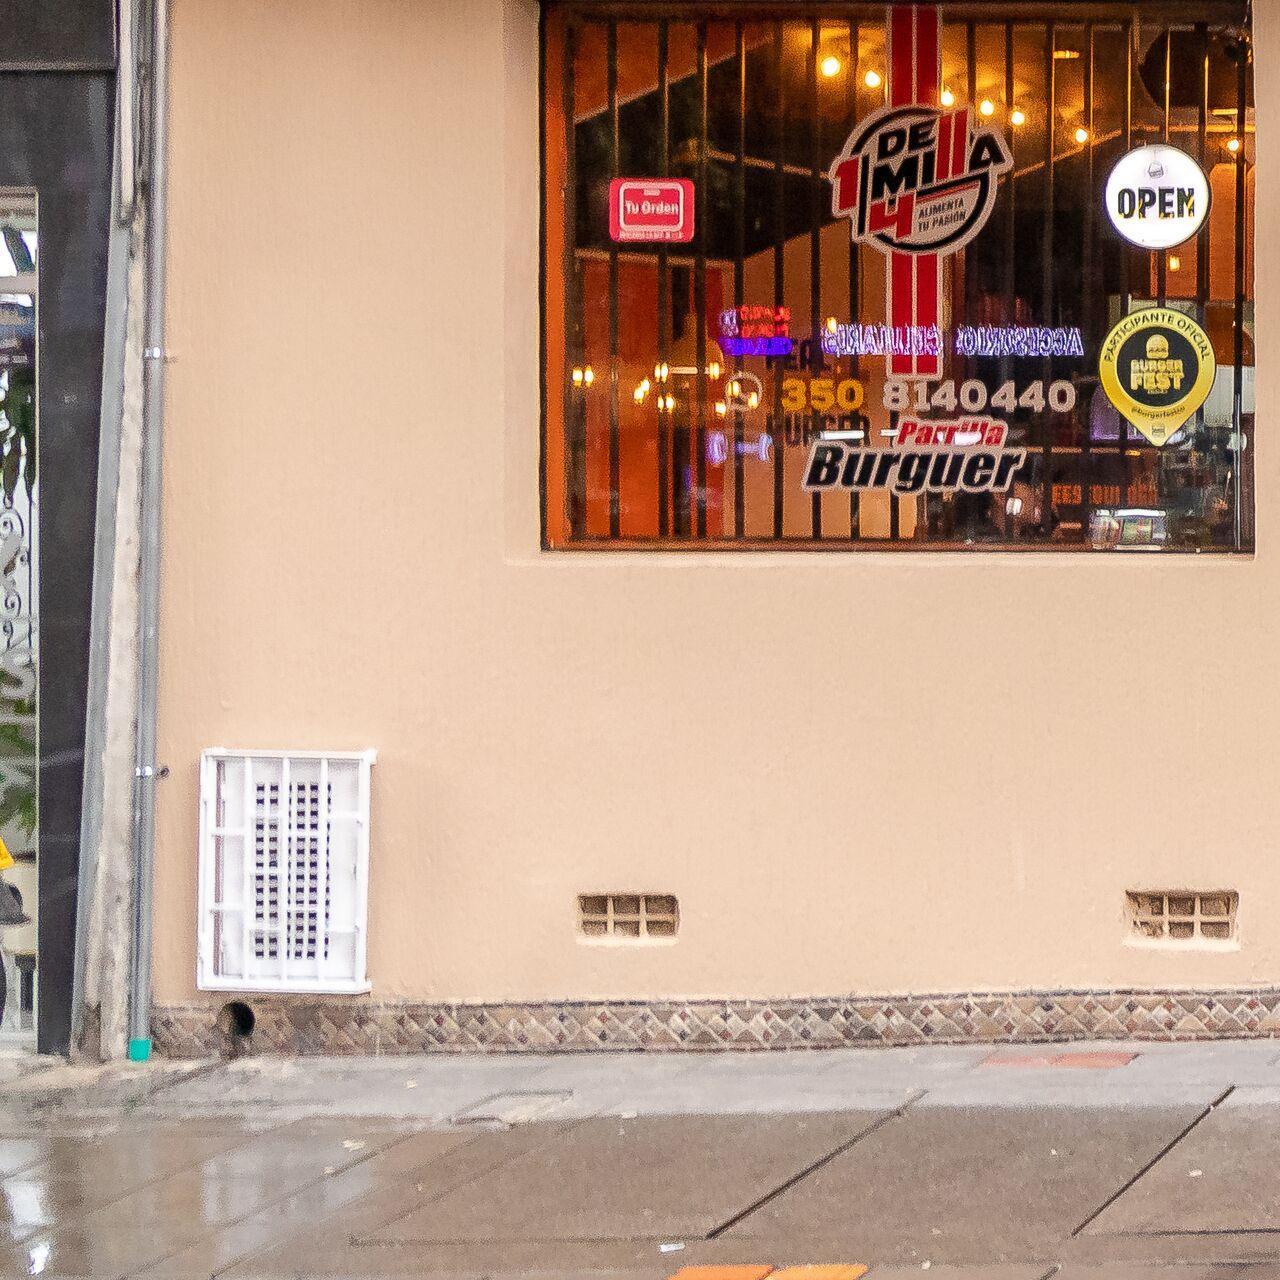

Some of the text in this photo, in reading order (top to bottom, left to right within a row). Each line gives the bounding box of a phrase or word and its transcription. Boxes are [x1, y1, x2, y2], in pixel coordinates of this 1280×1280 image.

[877, 118, 938, 160] DE
[641, 200, 679, 215] Orden
[1117, 186, 1195, 219] OPEN
[1104, 312, 1210, 362] PARTICIPANTE OFICIAL
[1130, 359, 1183, 373] BURGER
[1130, 372, 1185, 391] FEST
[781, 377, 1076, 413] 350 8140440
[805, 444, 1023, 493] Burguer
